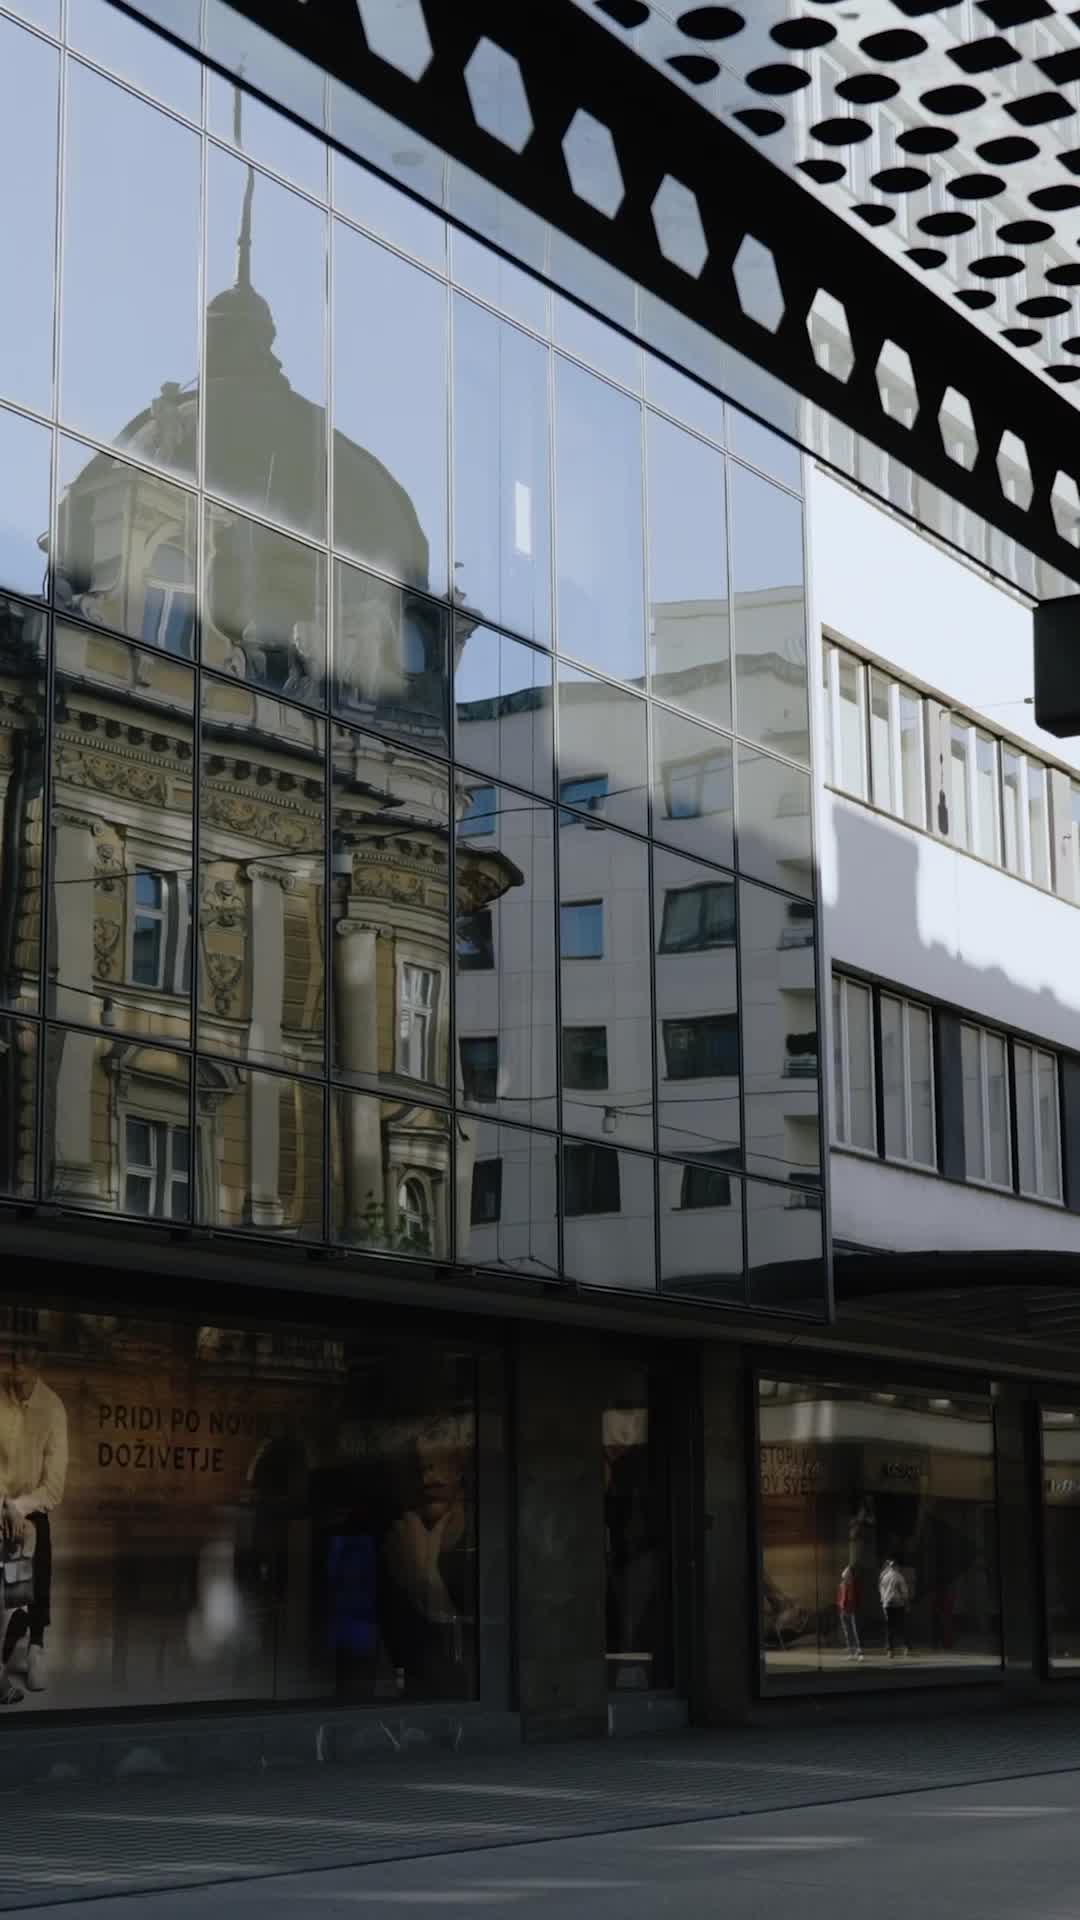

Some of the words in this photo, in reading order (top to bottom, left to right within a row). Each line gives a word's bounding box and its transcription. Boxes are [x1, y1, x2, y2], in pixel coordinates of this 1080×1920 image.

[98, 1404, 161, 1431] PRIDI
[171, 1407, 200, 1433] PO
[98, 1438, 225, 1472] DOŽIVETJE
